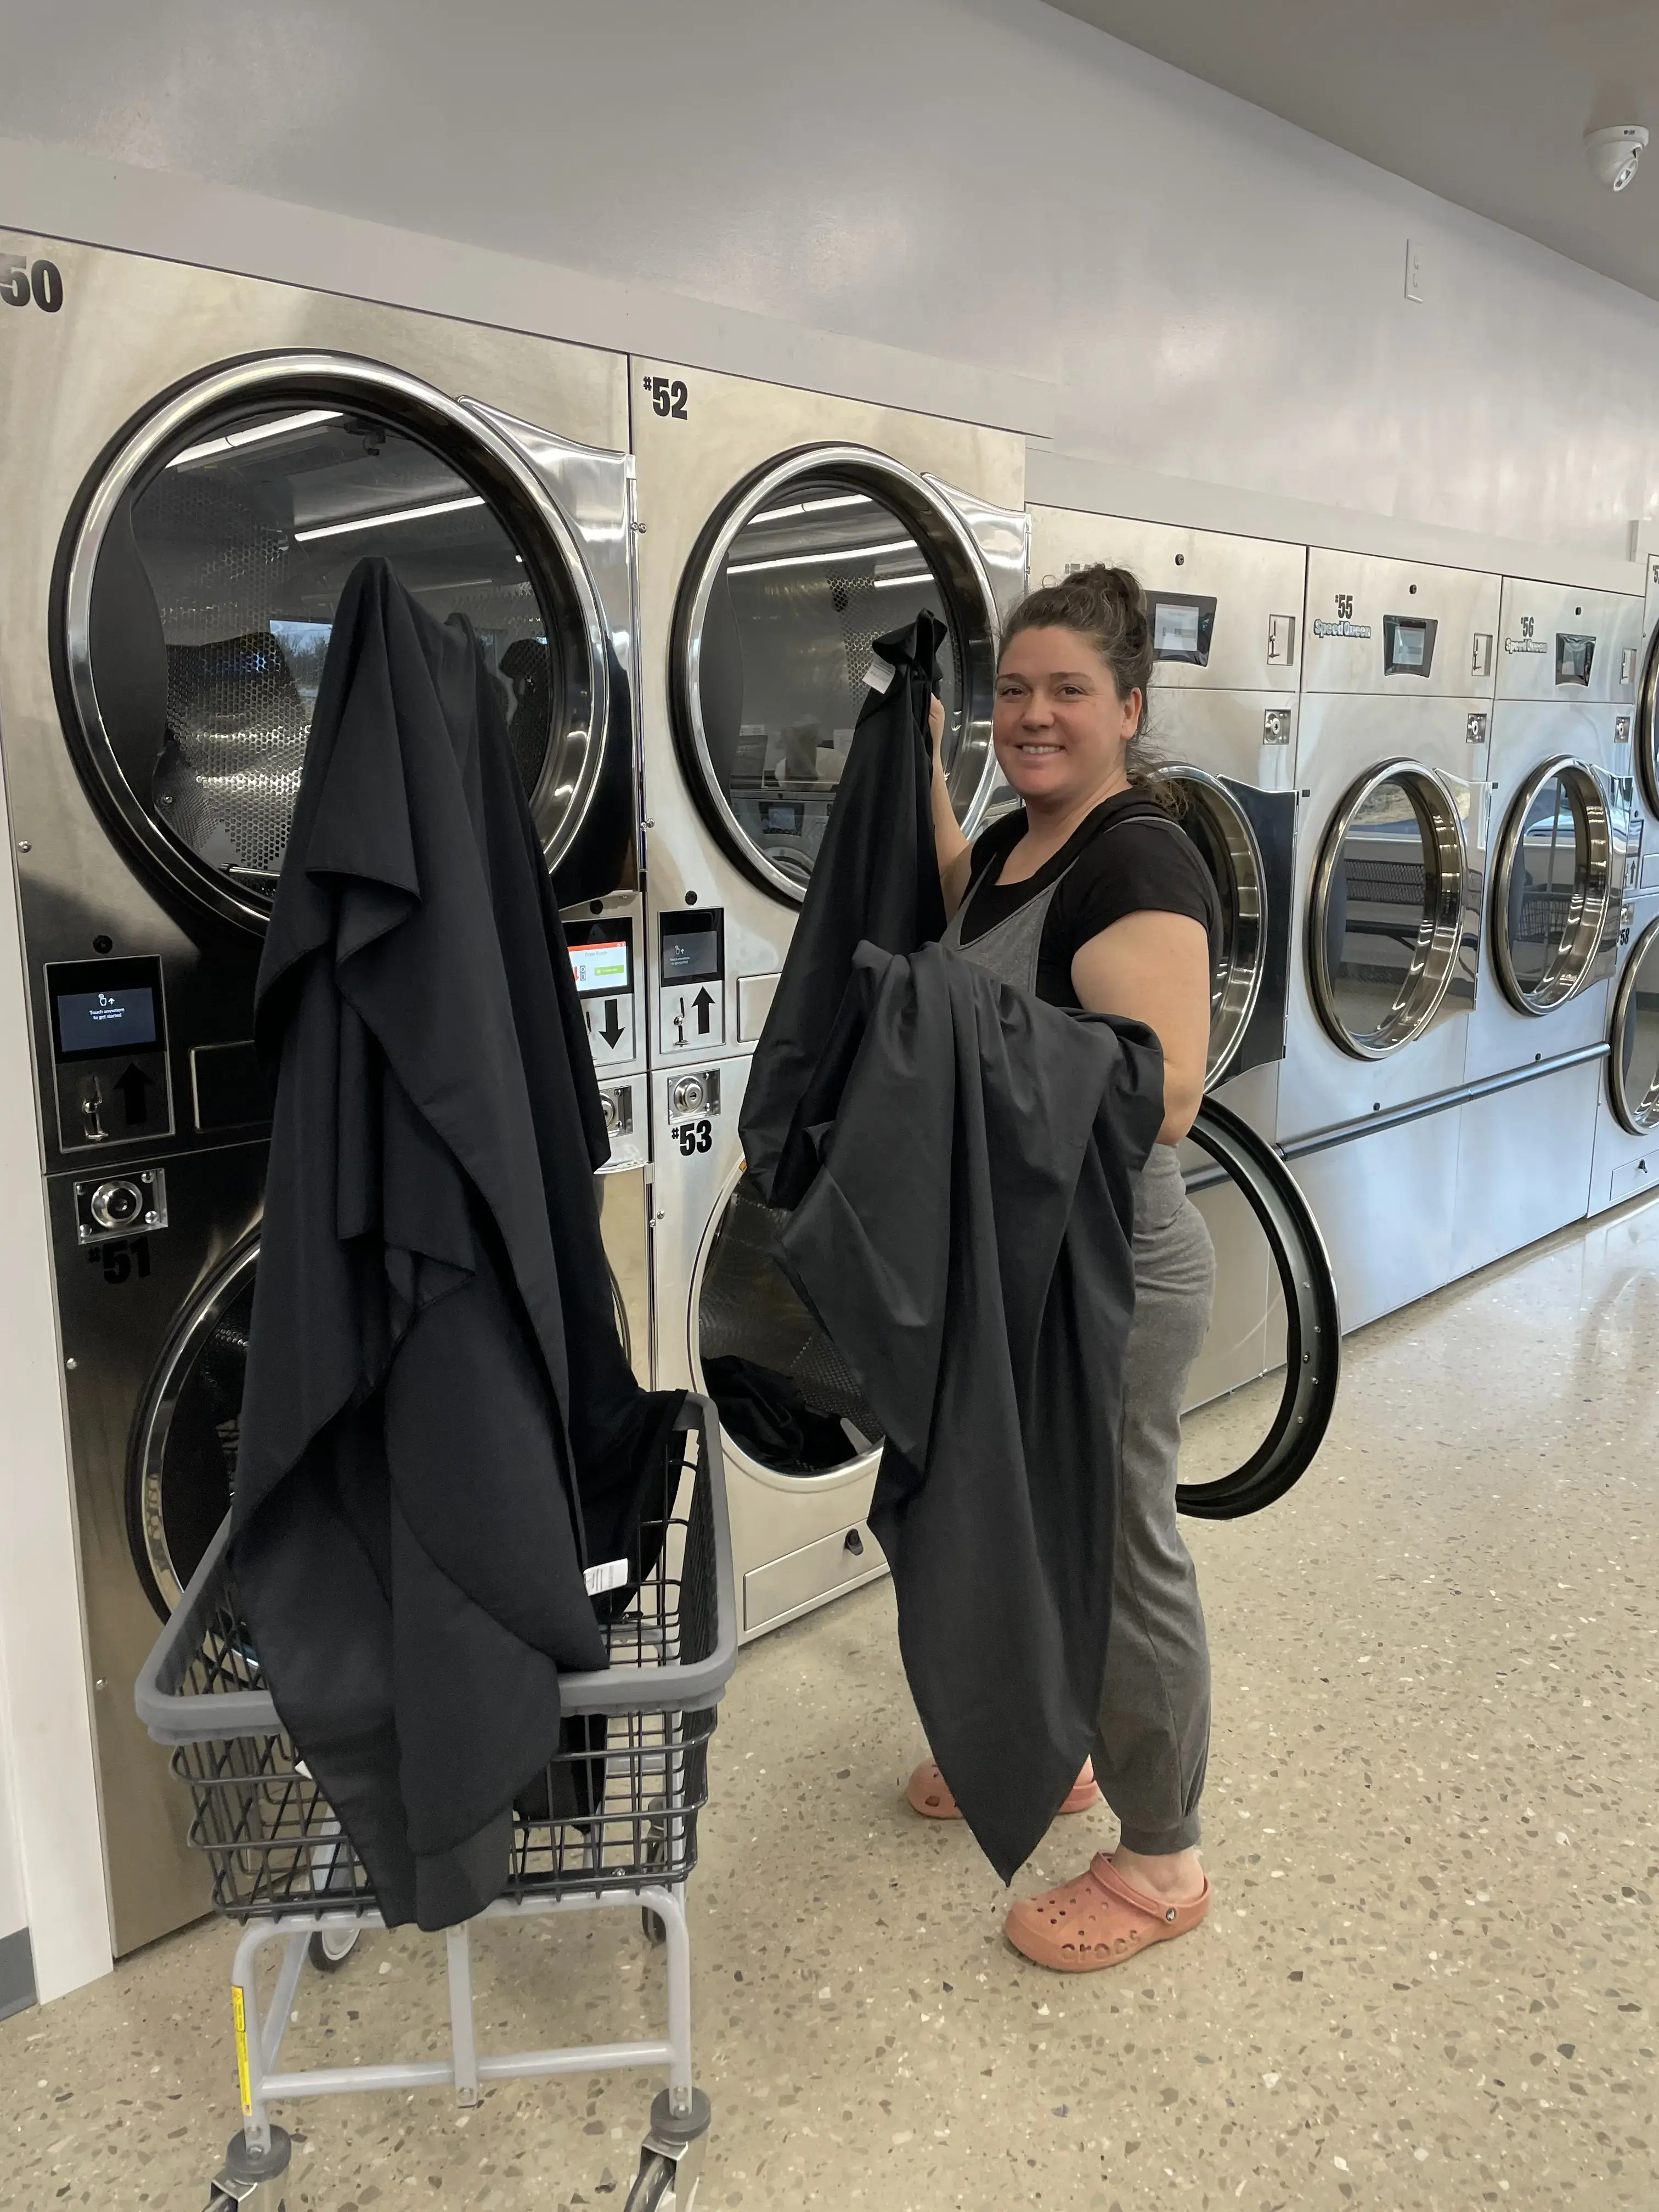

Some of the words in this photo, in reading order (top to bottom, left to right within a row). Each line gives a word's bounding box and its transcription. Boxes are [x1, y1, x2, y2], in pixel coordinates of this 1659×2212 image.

[0, 253, 63, 313] 50
[643, 376, 688, 420] #52
[1335, 594, 1353, 619] #55
[672, 1120, 712, 1156] #53
[89, 1235, 150, 1284] #51
[1062, 1929, 1141, 1961] crocs
